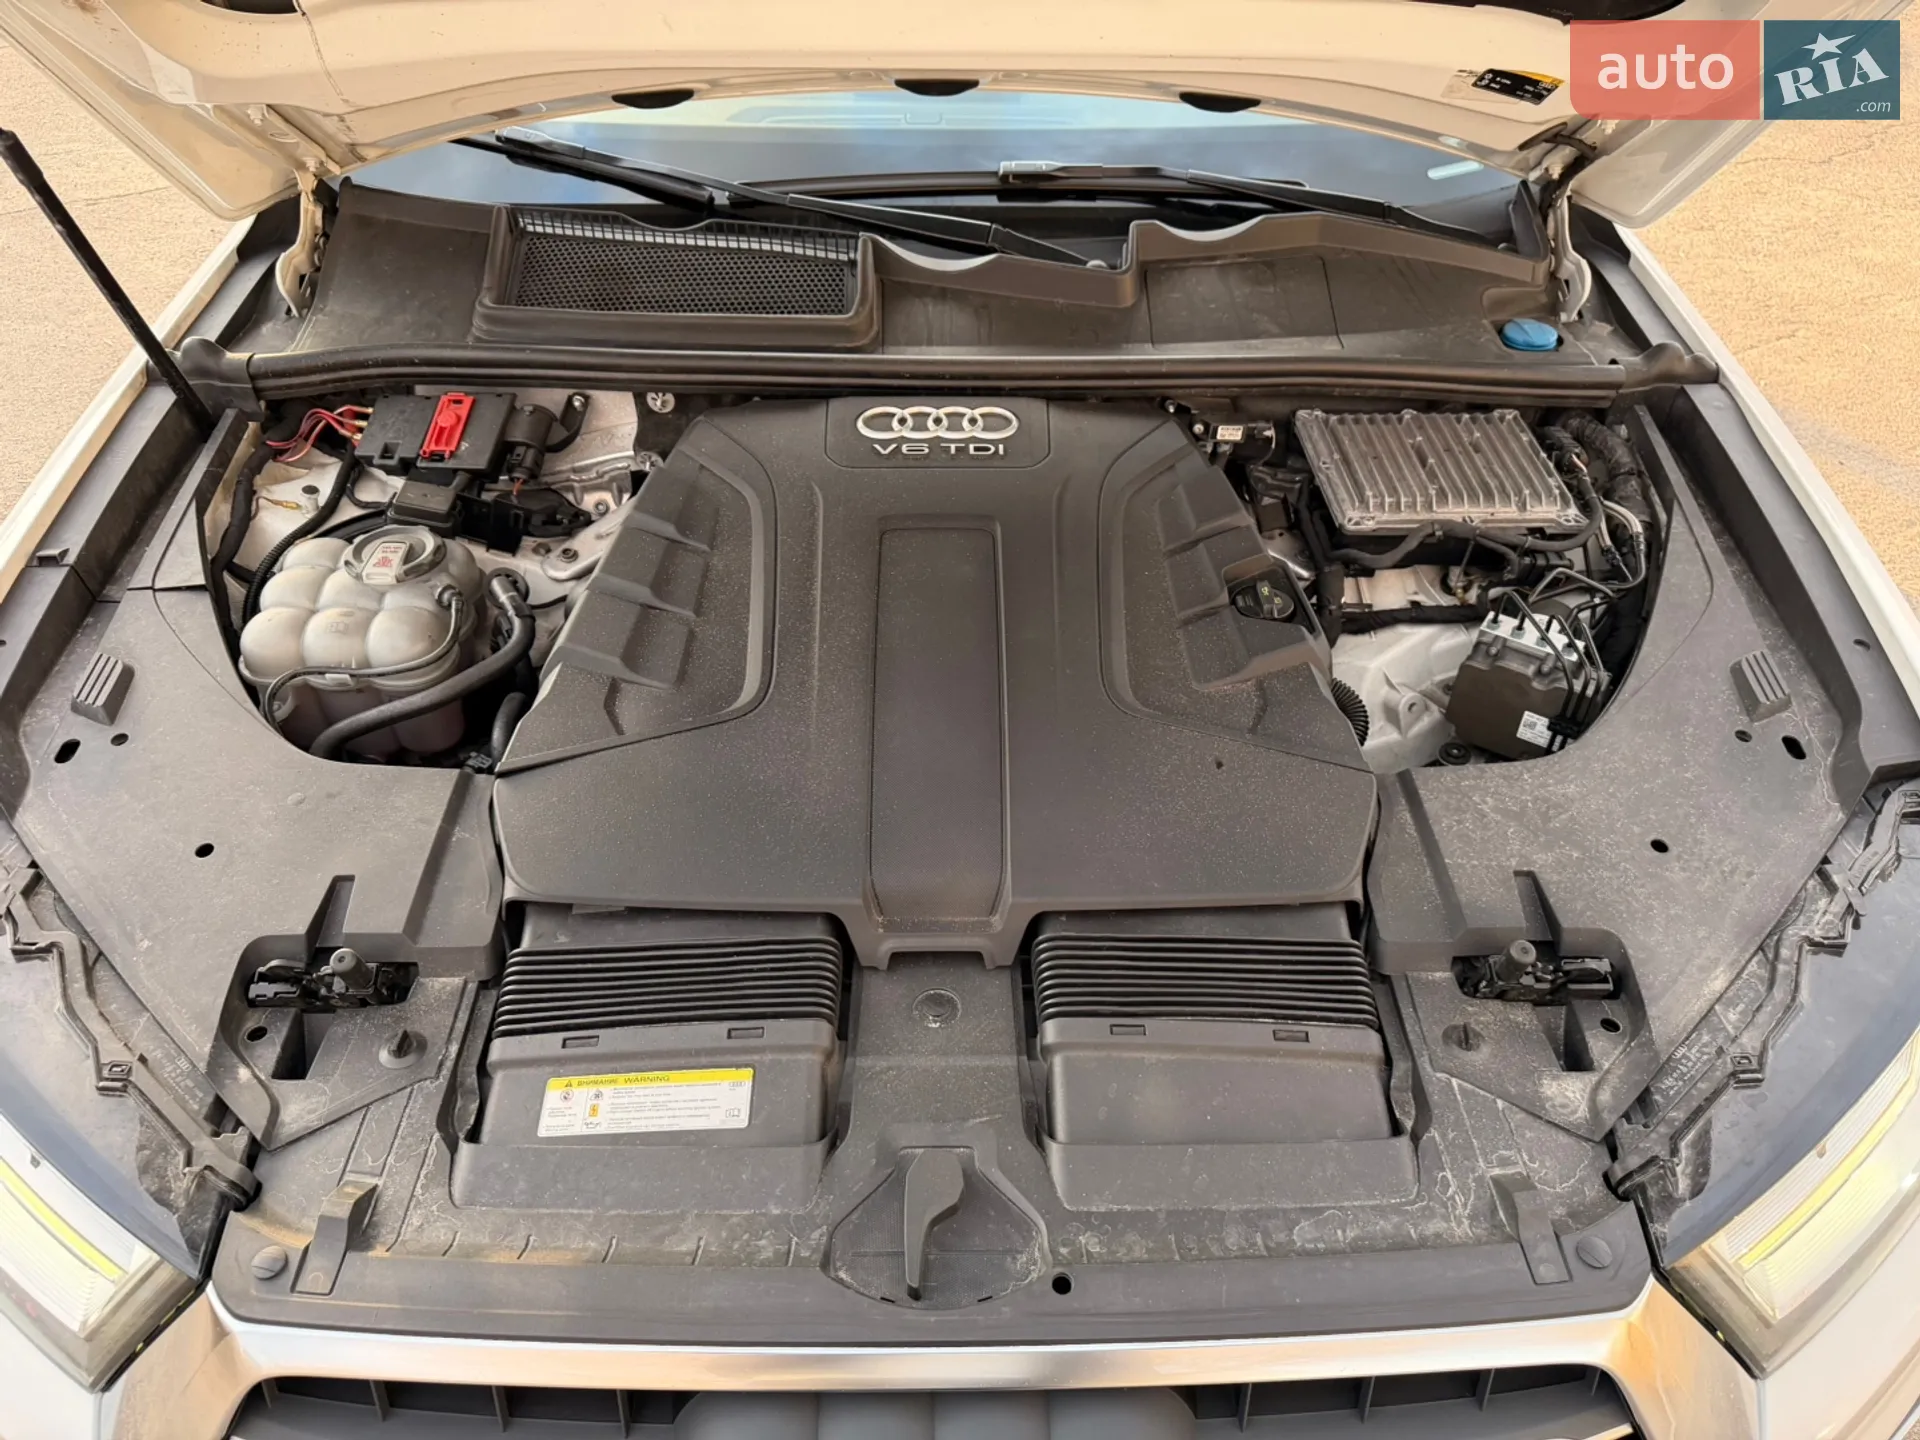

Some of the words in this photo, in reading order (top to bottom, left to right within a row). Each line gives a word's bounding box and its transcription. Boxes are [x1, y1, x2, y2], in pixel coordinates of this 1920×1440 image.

[872, 443, 929, 455] V6
[940, 443, 1004, 455] TDI
[624, 1075, 671, 1084] WARNING
